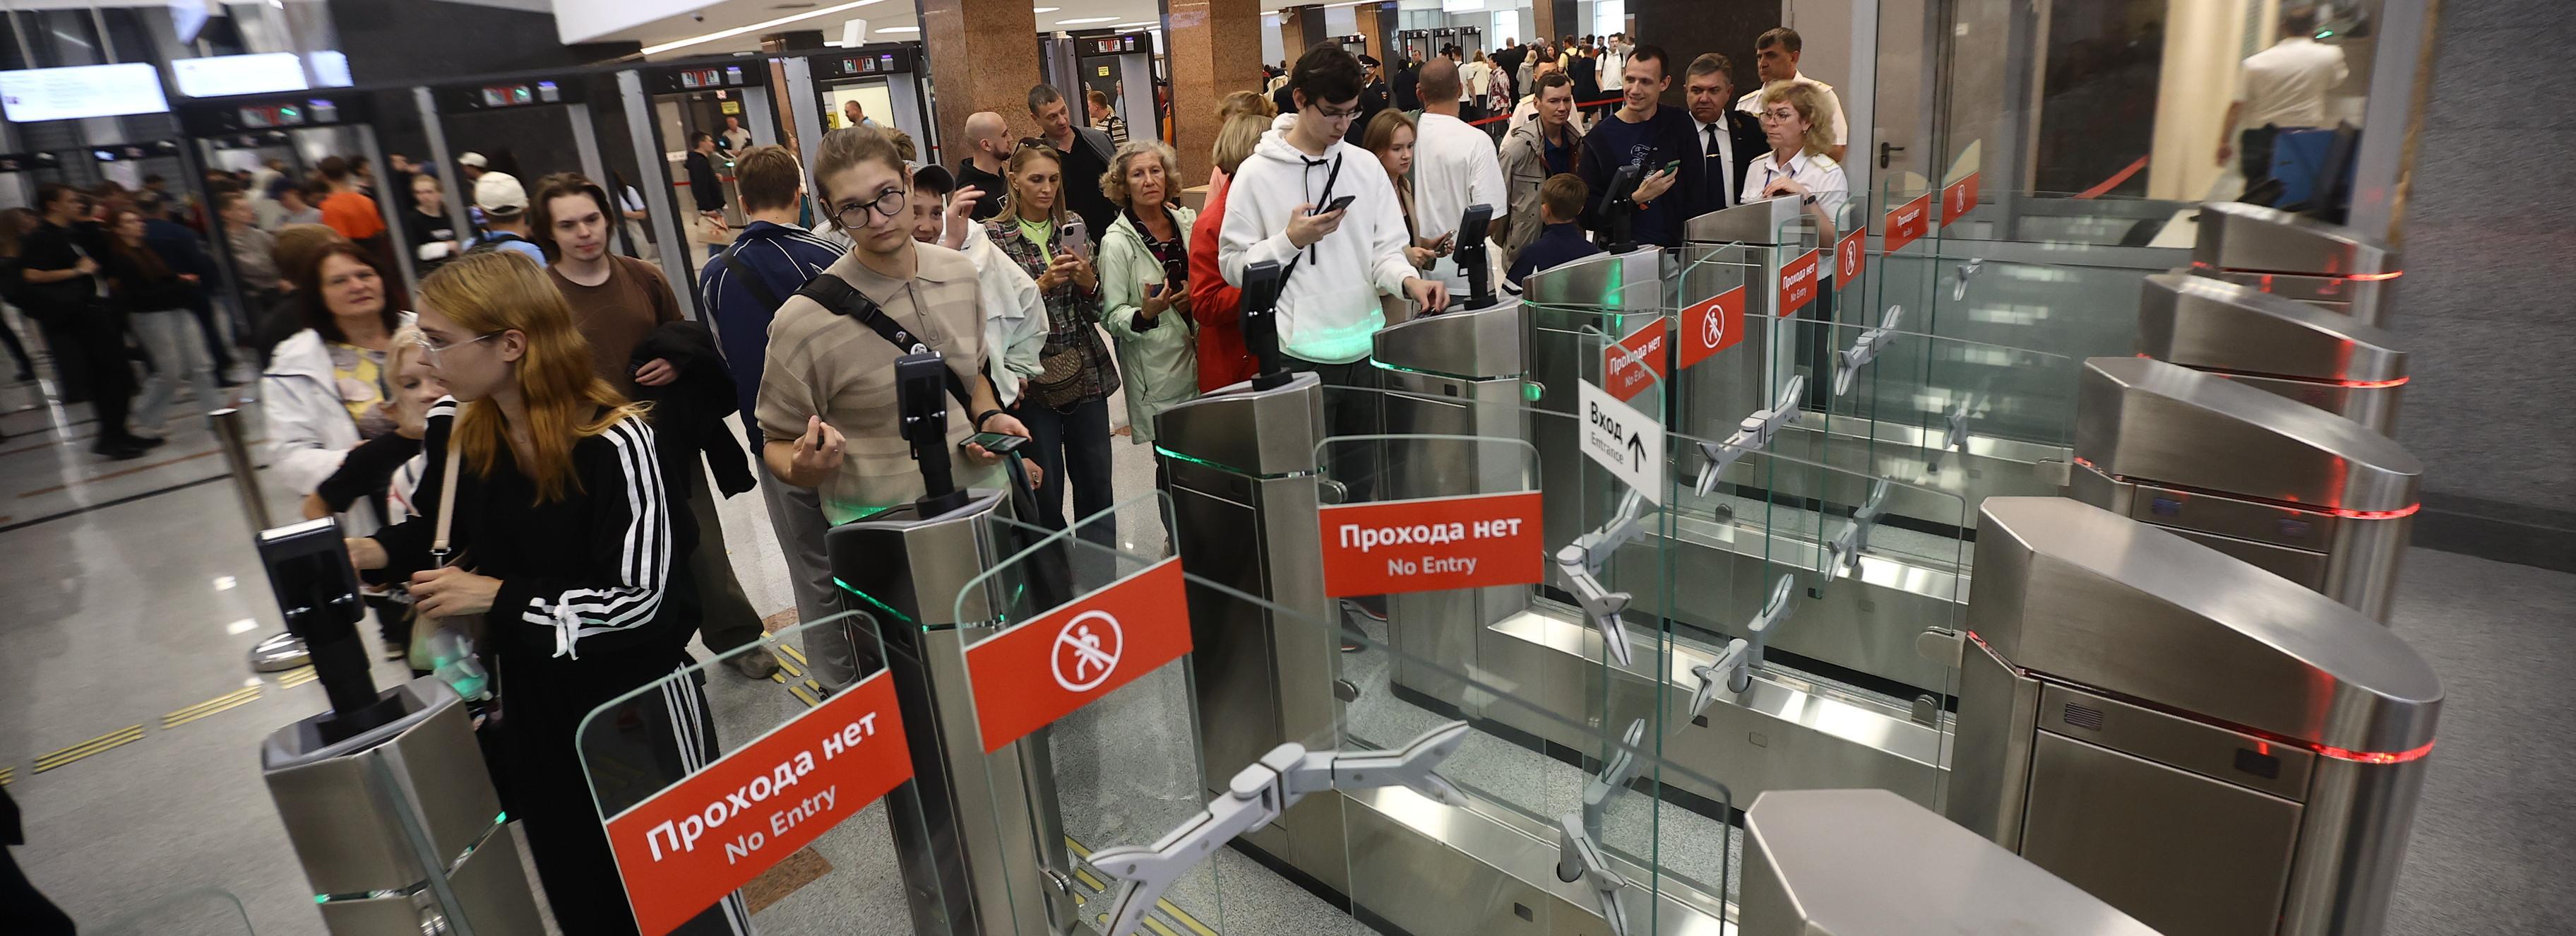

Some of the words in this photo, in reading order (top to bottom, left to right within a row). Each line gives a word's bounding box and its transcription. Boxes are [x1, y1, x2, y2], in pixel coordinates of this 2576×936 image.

[1783, 268, 1806, 292] Прохода
[1806, 263, 1815, 276] нет
[1790, 292, 1796, 302] No
[1796, 287, 1807, 299] Entry
[1648, 336, 1662, 353] нет
[1626, 376, 1634, 388] No
[1591, 401, 1623, 444] Вход
[1591, 431, 1624, 464] Entrance
[1339, 521, 1465, 553] Прохода
[1473, 517, 1522, 540] нет
[1387, 558, 1417, 577] No
[1422, 556, 1477, 576] Entry
[645, 750, 816, 863] Прохода
[822, 711, 878, 761] нет
[724, 831, 765, 865] No
[769, 784, 837, 839] Entry
